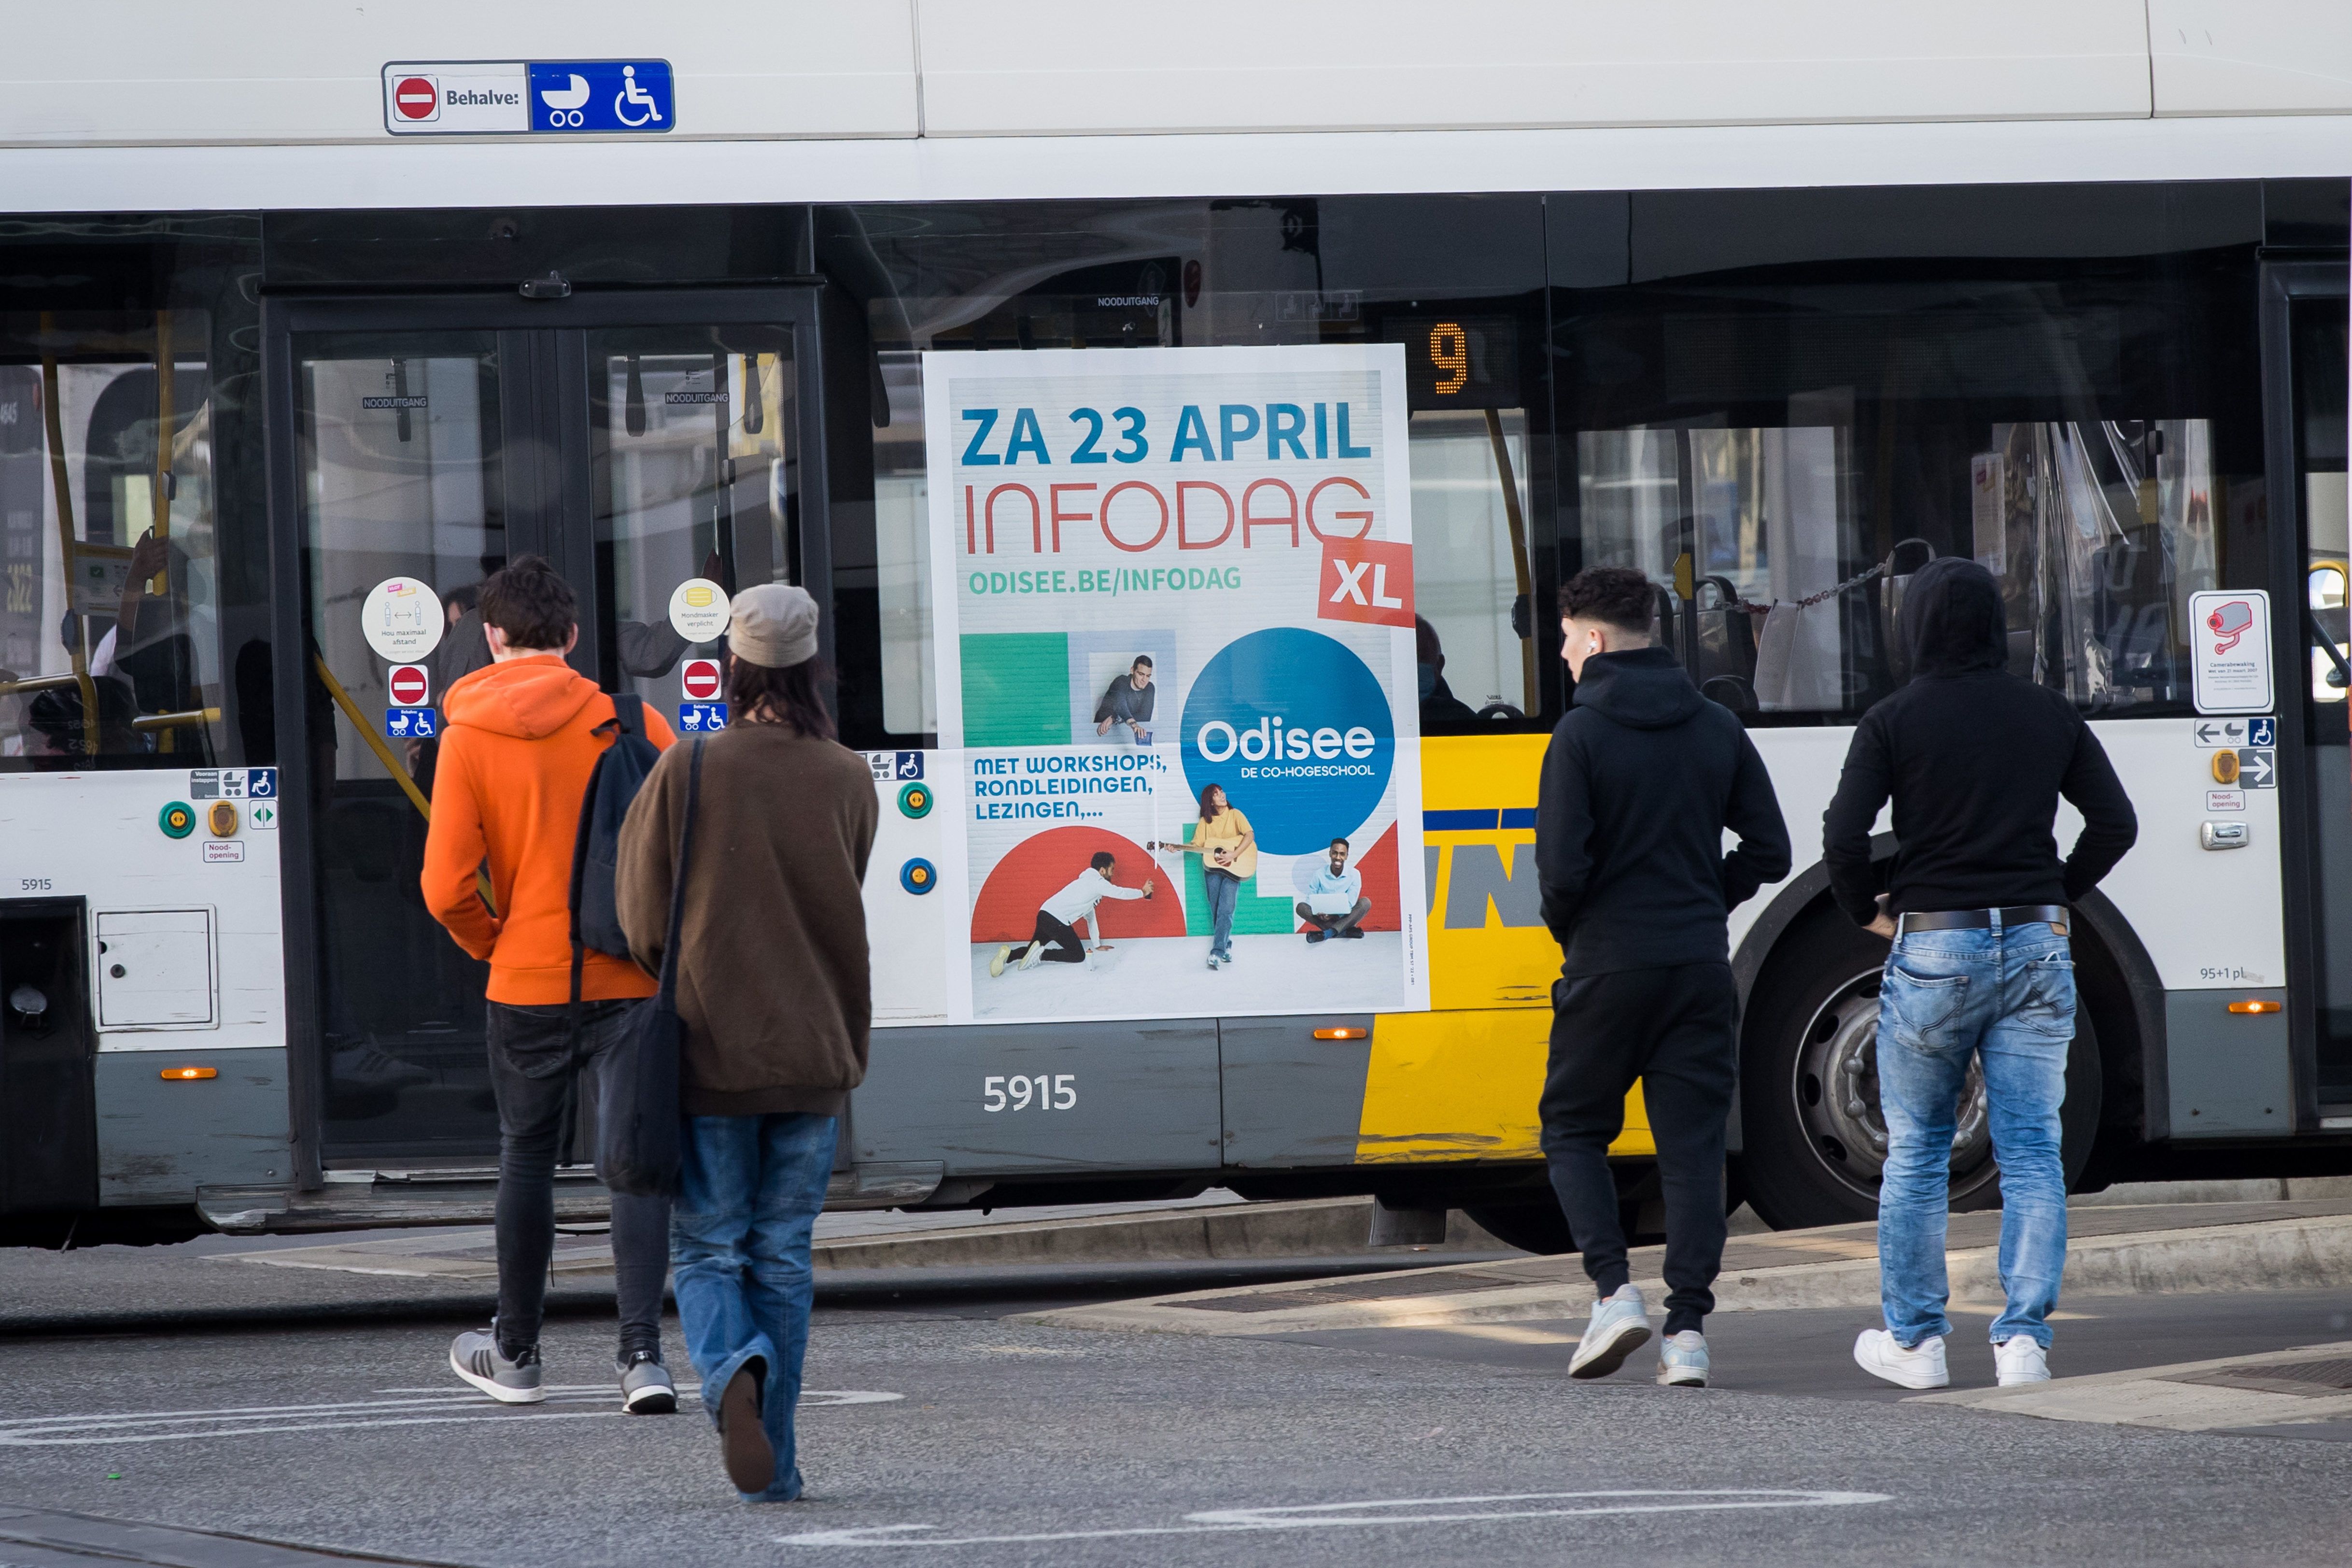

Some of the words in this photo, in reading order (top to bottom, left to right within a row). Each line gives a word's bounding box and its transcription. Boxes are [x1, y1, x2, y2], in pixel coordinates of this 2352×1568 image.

[446, 89, 519, 105] Behalve:
[1098, 297, 1159, 307] NOODUITGANG
[1430, 323, 1466, 394] 9
[364, 397, 427, 408] NOODUITGANG
[666, 393, 729, 403] NOODUITGANG
[961, 408, 1051, 466] ZA
[1069, 407, 1149, 464] 23
[1170, 402, 1371, 463] APRIL
[966, 476, 1374, 554] INFODAG
[969, 567, 1241, 596] ODISEE.BE/INFODAG
[1329, 559, 1402, 609] XL
[1197, 716, 1375, 762] Odisee
[974, 758, 1020, 775] MET
[1026, 754, 1167, 774] WORKSHOPS,
[1241, 767, 1258, 778] DE
[1261, 765, 1375, 777] CO-HOGESCHOOL
[974, 776, 1153, 797] RONDLEIDINGEN,
[2212, 800, 2240, 808] opening
[209, 851, 239, 860] opening
[21, 878, 52, 891] 5915
[2200, 968, 2229, 979] 95+1
[983, 1074, 1077, 1112] 5915
